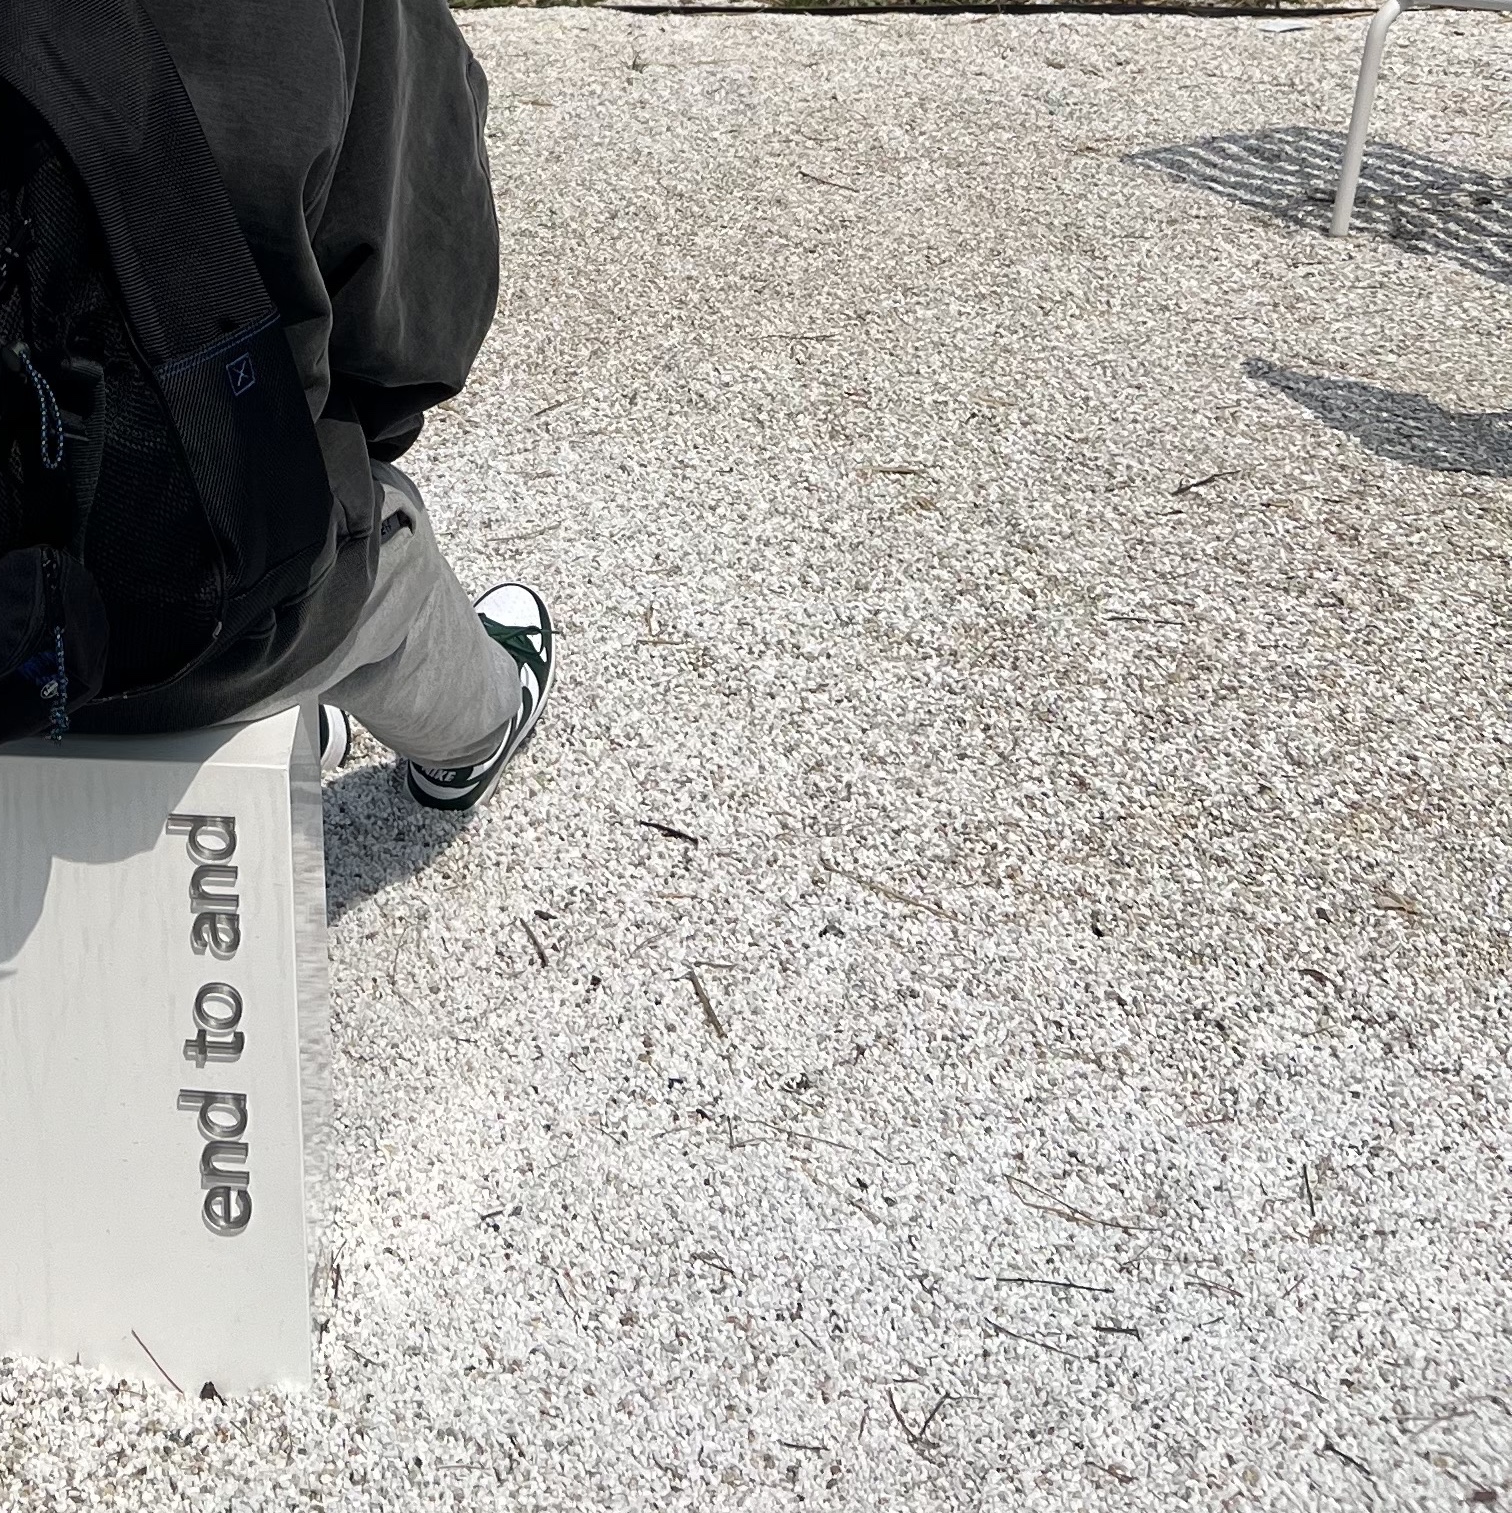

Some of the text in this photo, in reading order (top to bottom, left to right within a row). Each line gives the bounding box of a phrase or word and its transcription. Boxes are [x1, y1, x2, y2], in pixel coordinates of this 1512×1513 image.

[166, 813, 253, 1237] end to and
